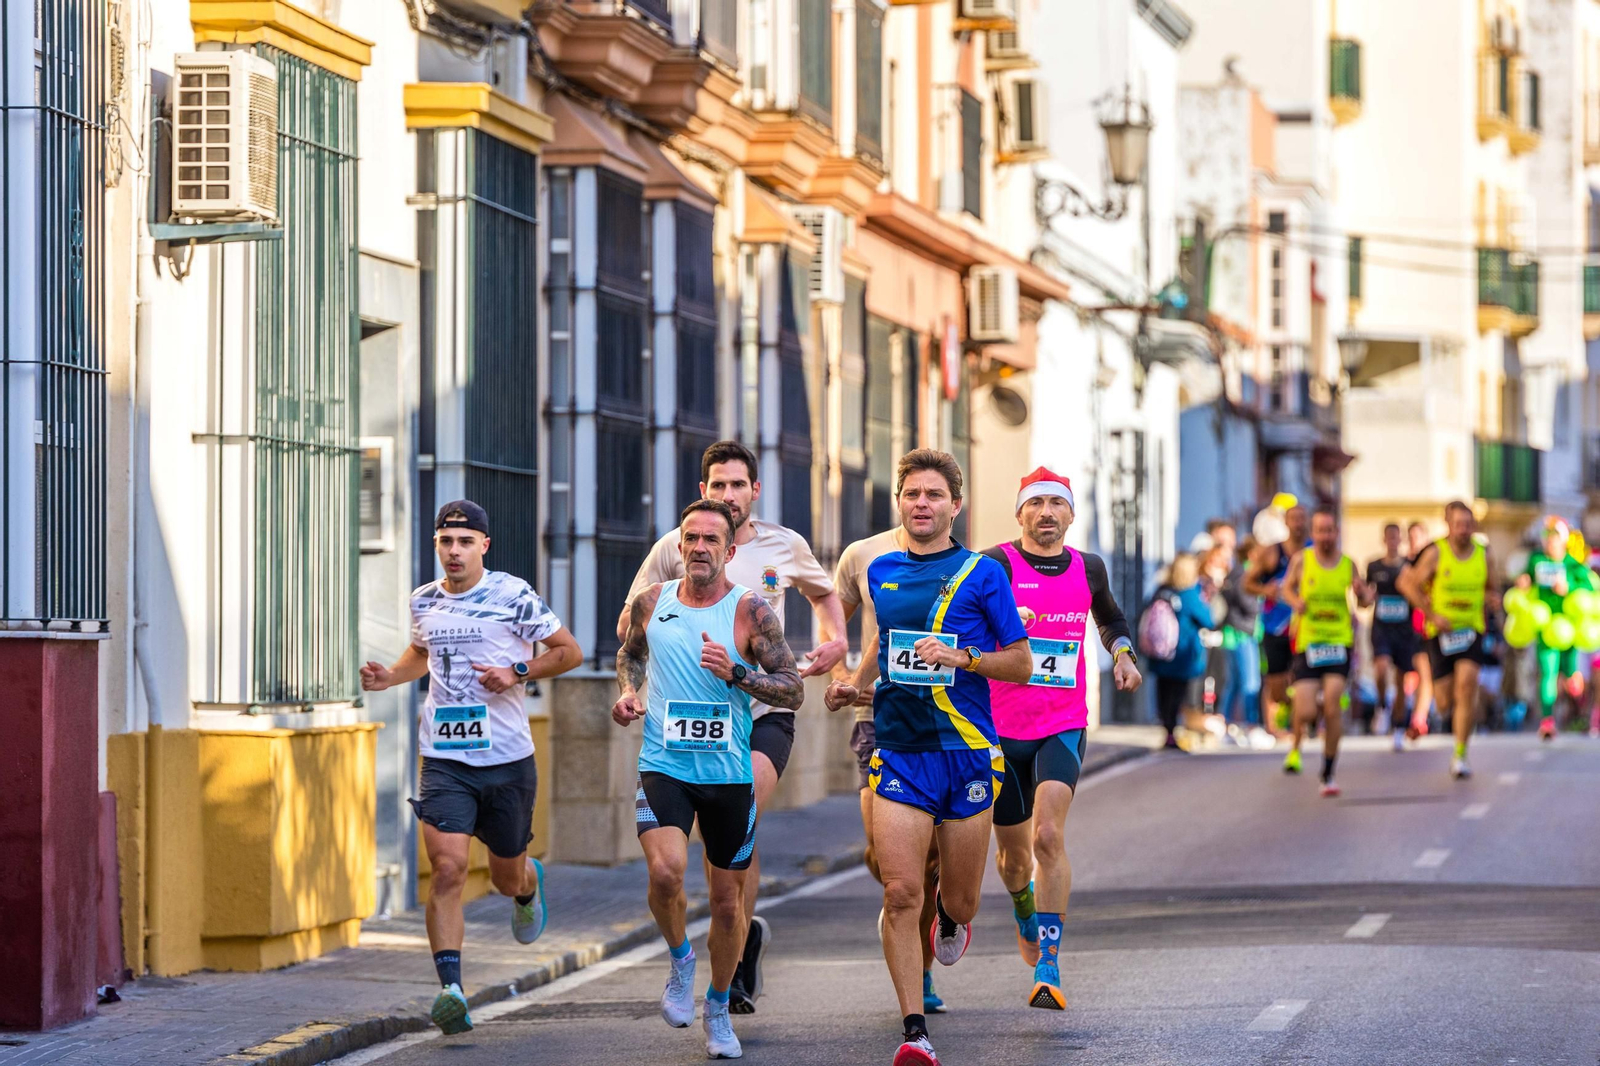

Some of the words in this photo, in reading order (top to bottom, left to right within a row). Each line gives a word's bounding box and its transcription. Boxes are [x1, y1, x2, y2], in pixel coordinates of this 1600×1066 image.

[428, 626, 482, 636] MEMORIAL
[1041, 656, 1056, 673] 4
[438, 721, 483, 739] 444
[674, 719, 724, 739] 198
